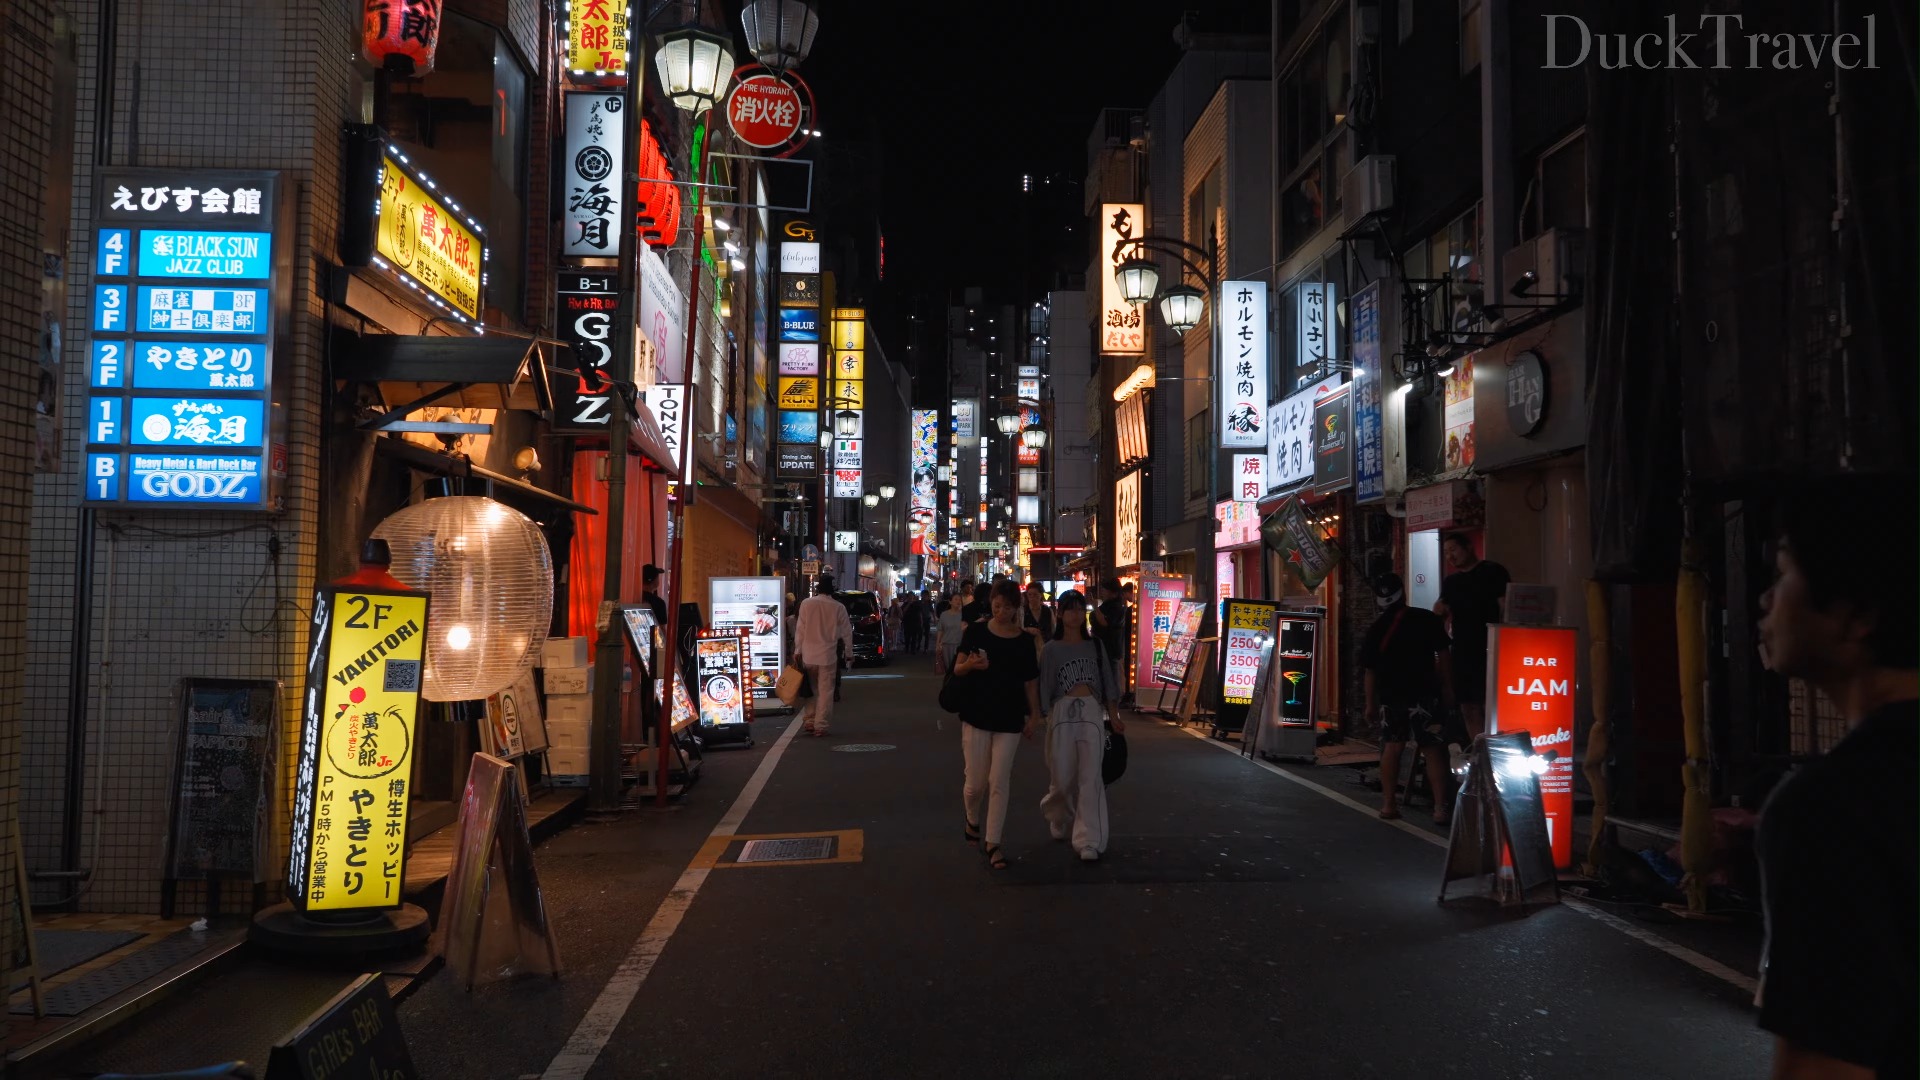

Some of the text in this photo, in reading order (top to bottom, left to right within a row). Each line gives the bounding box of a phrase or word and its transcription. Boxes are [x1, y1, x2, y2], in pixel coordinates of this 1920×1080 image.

[743, 84, 790, 95] FIRE HYDRANT
[607, 99, 620, 112] 1F
[735, 95, 795, 127] 消火栓
[381, 163, 395, 204] 2F
[110, 185, 261, 214] えびす会館
[569, 183, 618, 250] 海月
[176, 236, 258, 258] BLACK SUN
[421, 200, 470, 269] 萬太郎
[105, 233, 123, 274] 4F
[166, 258, 243, 274] JAZZ CLUB
[579, 278, 609, 290] B-1
[103, 288, 120, 329] 3F
[153, 292, 253, 309] 麻雀 3F
[568, 297, 618, 310] HM & HR BA
[152, 312, 252, 329] 紳士倶楽部
[1107, 309, 1140, 328] 酒場
[1107, 331, 1140, 347] だしや
[1236, 288, 1255, 397] ホルモン焼肉
[100, 345, 117, 386] 2F
[147, 345, 252, 372] やきとり
[843, 356, 858, 373] 幸
[1508, 365, 1525, 378] BAR
[781, 395, 815, 404] RUN
[843, 381, 858, 397] 永
[98, 400, 115, 442] 1F
[174, 411, 247, 444] 海月
[1272, 400, 1307, 438] ホルモン
[135, 457, 257, 471] Heavy Metal & Hard Rock Bar
[1276, 436, 1302, 479] 焼肉
[96, 457, 115, 499] B1
[142, 471, 248, 500] GODZ
[1242, 458, 1260, 498] 焼肉
[1144, 582, 1159, 590] FREE
[345, 595, 393, 629] 2F
[333, 618, 420, 687] YAKITORI
[1231, 637, 1261, 649] 2500
[704, 657, 734, 668] 営業中
[1229, 655, 1261, 667] 3500
[1523, 657, 1557, 667] BAR
[1507, 678, 1568, 696] JAM
[1531, 701, 1548, 711] B1
[358, 712, 379, 767] 萬太郎
[311, 776, 334, 903] PM5時から営業中
[344, 788, 375, 895] やきとり
[382, 779, 405, 899] 樽生ホッピー
[352, 998, 384, 1044] BAR
